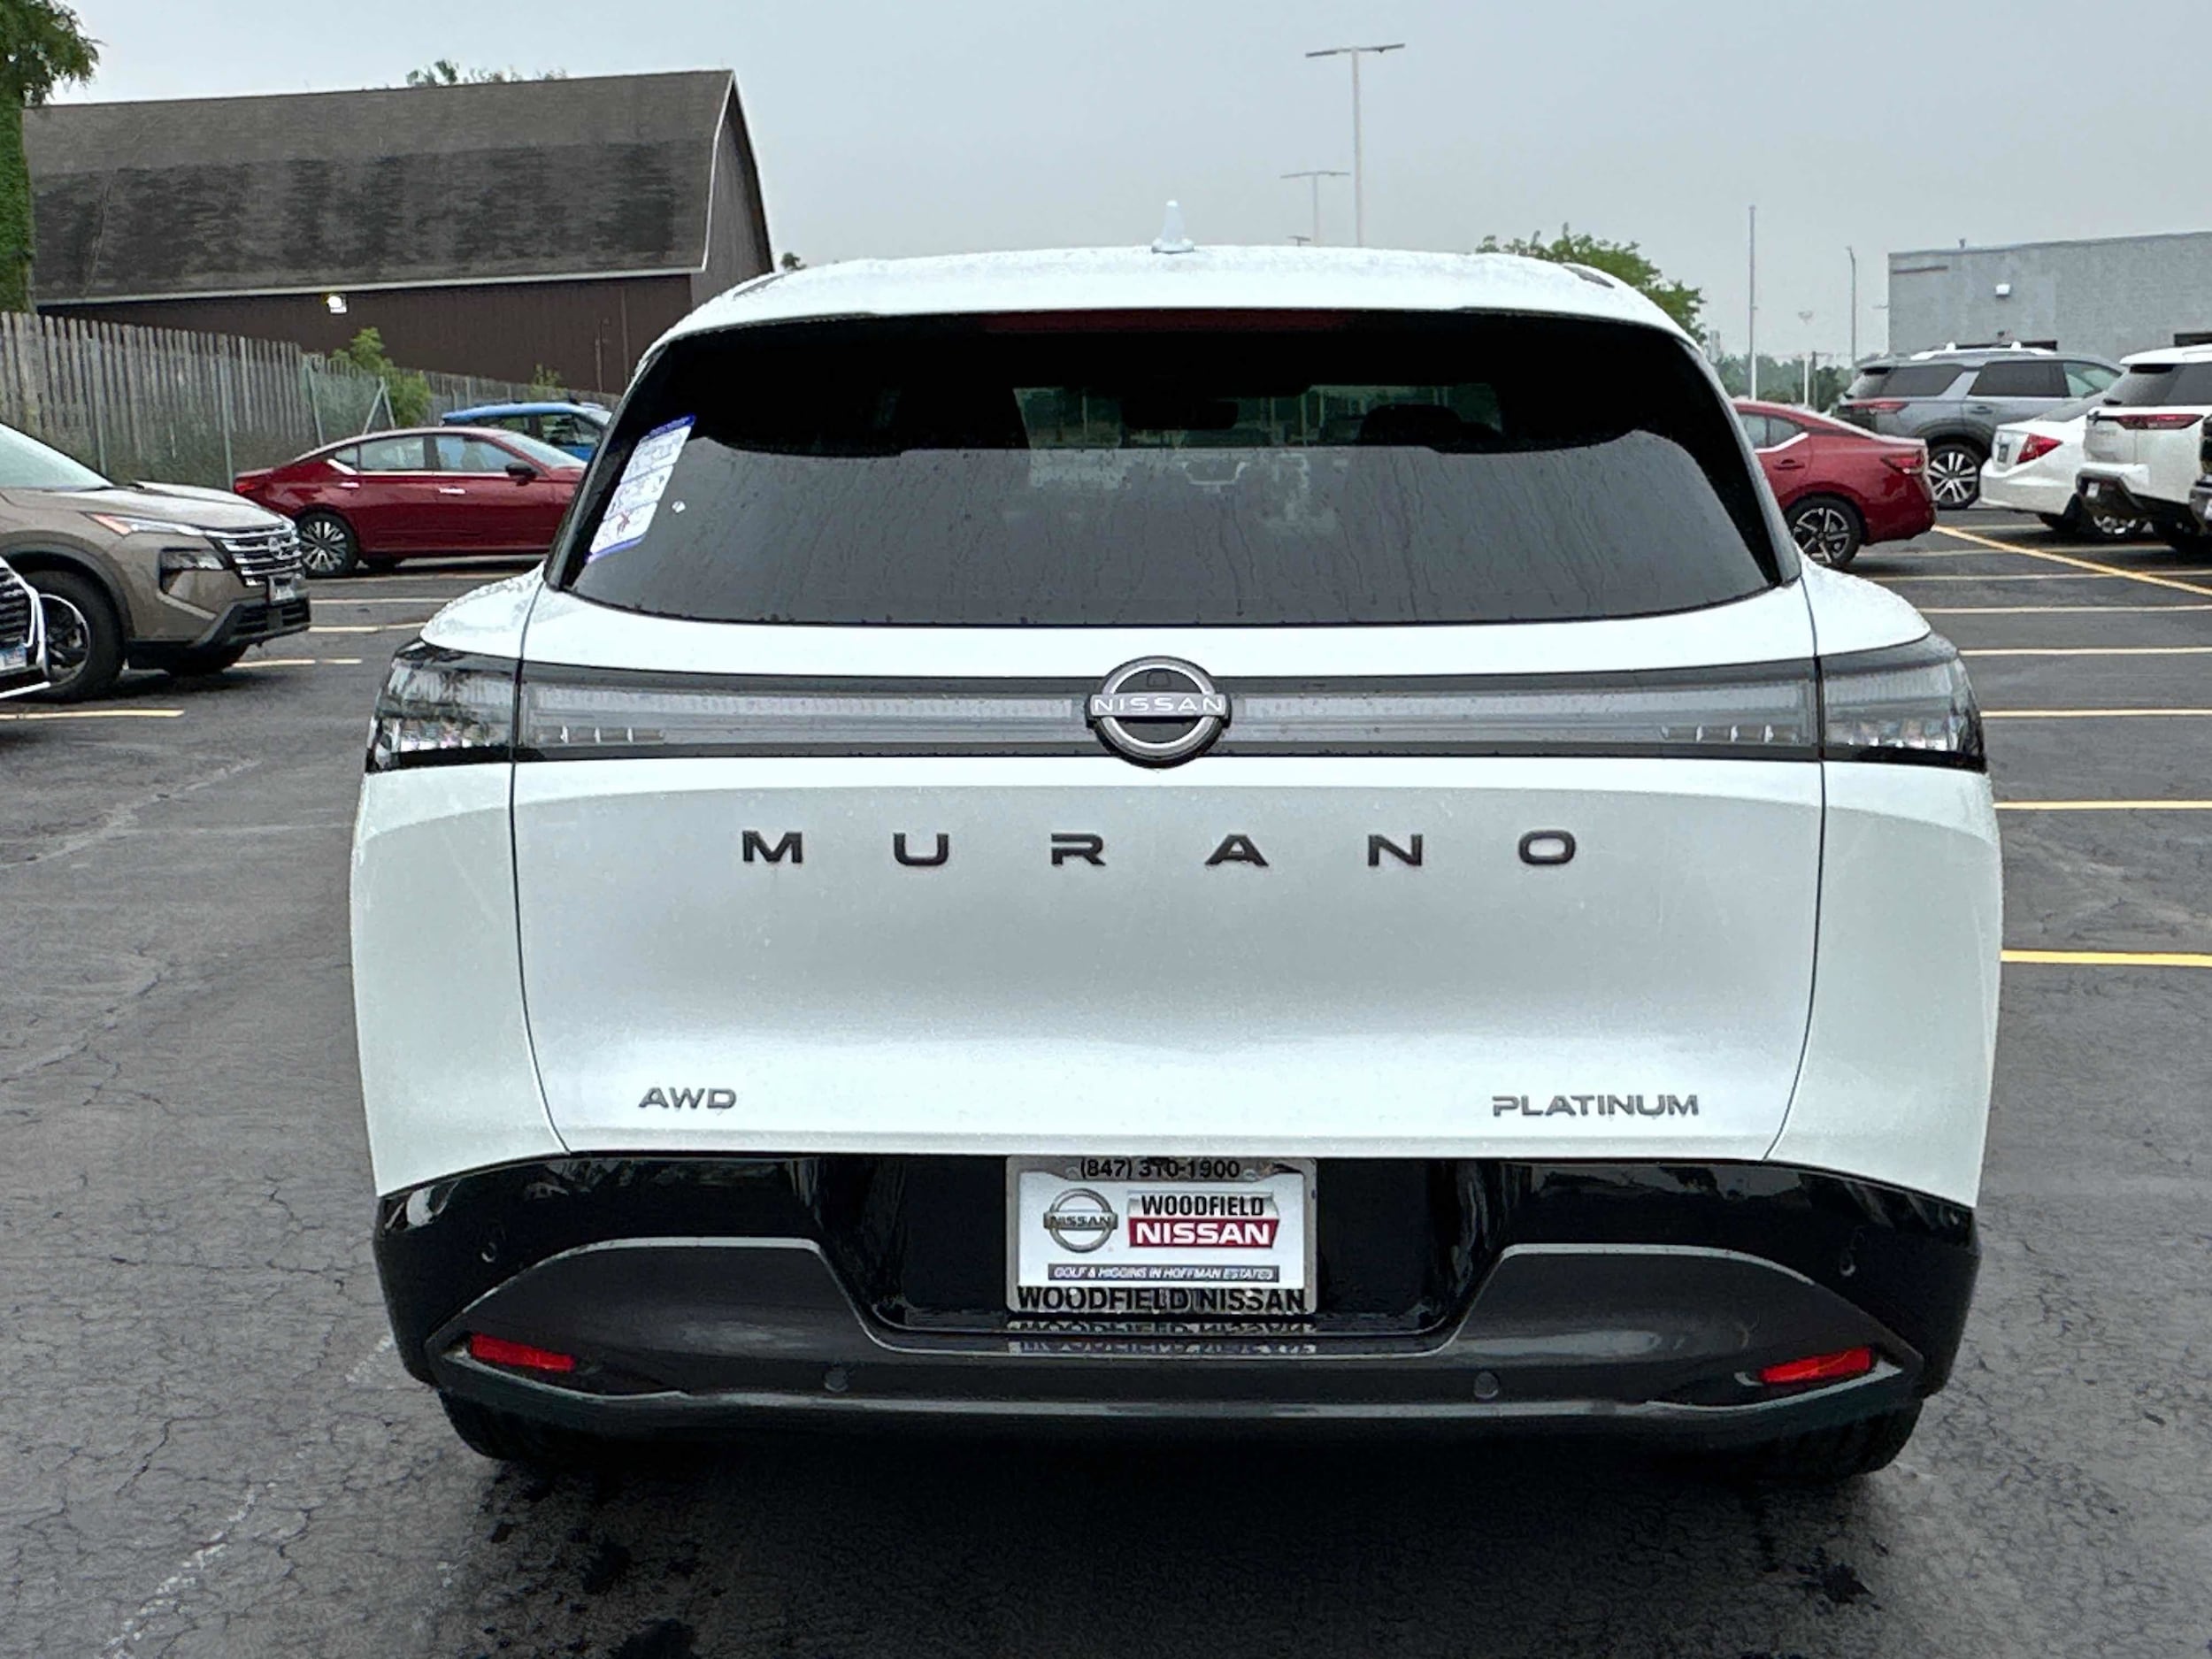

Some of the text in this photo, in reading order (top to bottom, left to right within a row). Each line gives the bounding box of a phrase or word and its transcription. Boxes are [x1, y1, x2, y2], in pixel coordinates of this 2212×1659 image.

[1094, 696, 1223, 712] NISSAN
[741, 828, 1577, 868] MURANO
[638, 1087, 737, 1110] AWD
[1492, 1094, 1700, 1117] PLATINUM
[1080, 1158, 1240, 1179] (847) 310-1900
[1141, 1195, 1264, 1216] WOODFIELD
[1050, 1215, 1111, 1227] NISSAN
[1136, 1222, 1271, 1245] NISSAN
[1054, 1266, 1087, 1279] GOLF
[1164, 1267, 1221, 1279] HOFFMAN
[1223, 1268, 1274, 1279] ESTATES
[1017, 1287, 1306, 1311] WOODFIELD NISSAN
